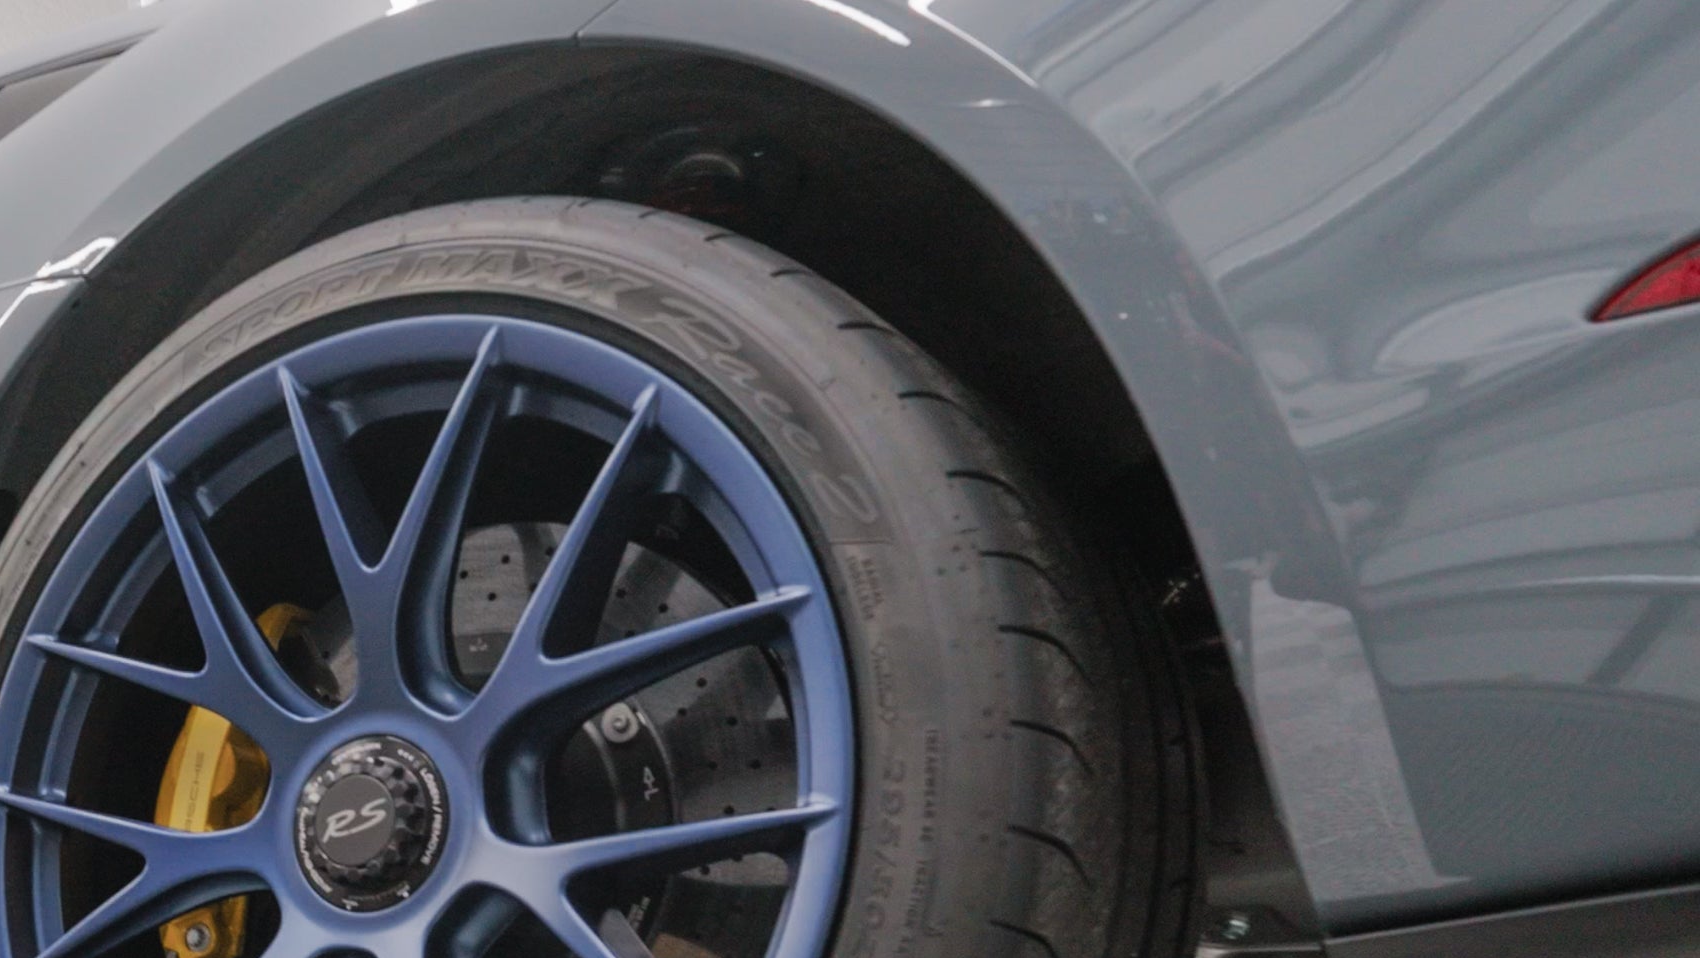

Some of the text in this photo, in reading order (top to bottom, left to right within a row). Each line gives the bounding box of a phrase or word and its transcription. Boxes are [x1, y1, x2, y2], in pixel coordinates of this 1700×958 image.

[198, 260, 401, 366] SPORT
[400, 248, 650, 311] MAXX
[640, 295, 823, 459] Race
[322, 798, 386, 843] RS
[421, 814, 443, 865] REMOVE
